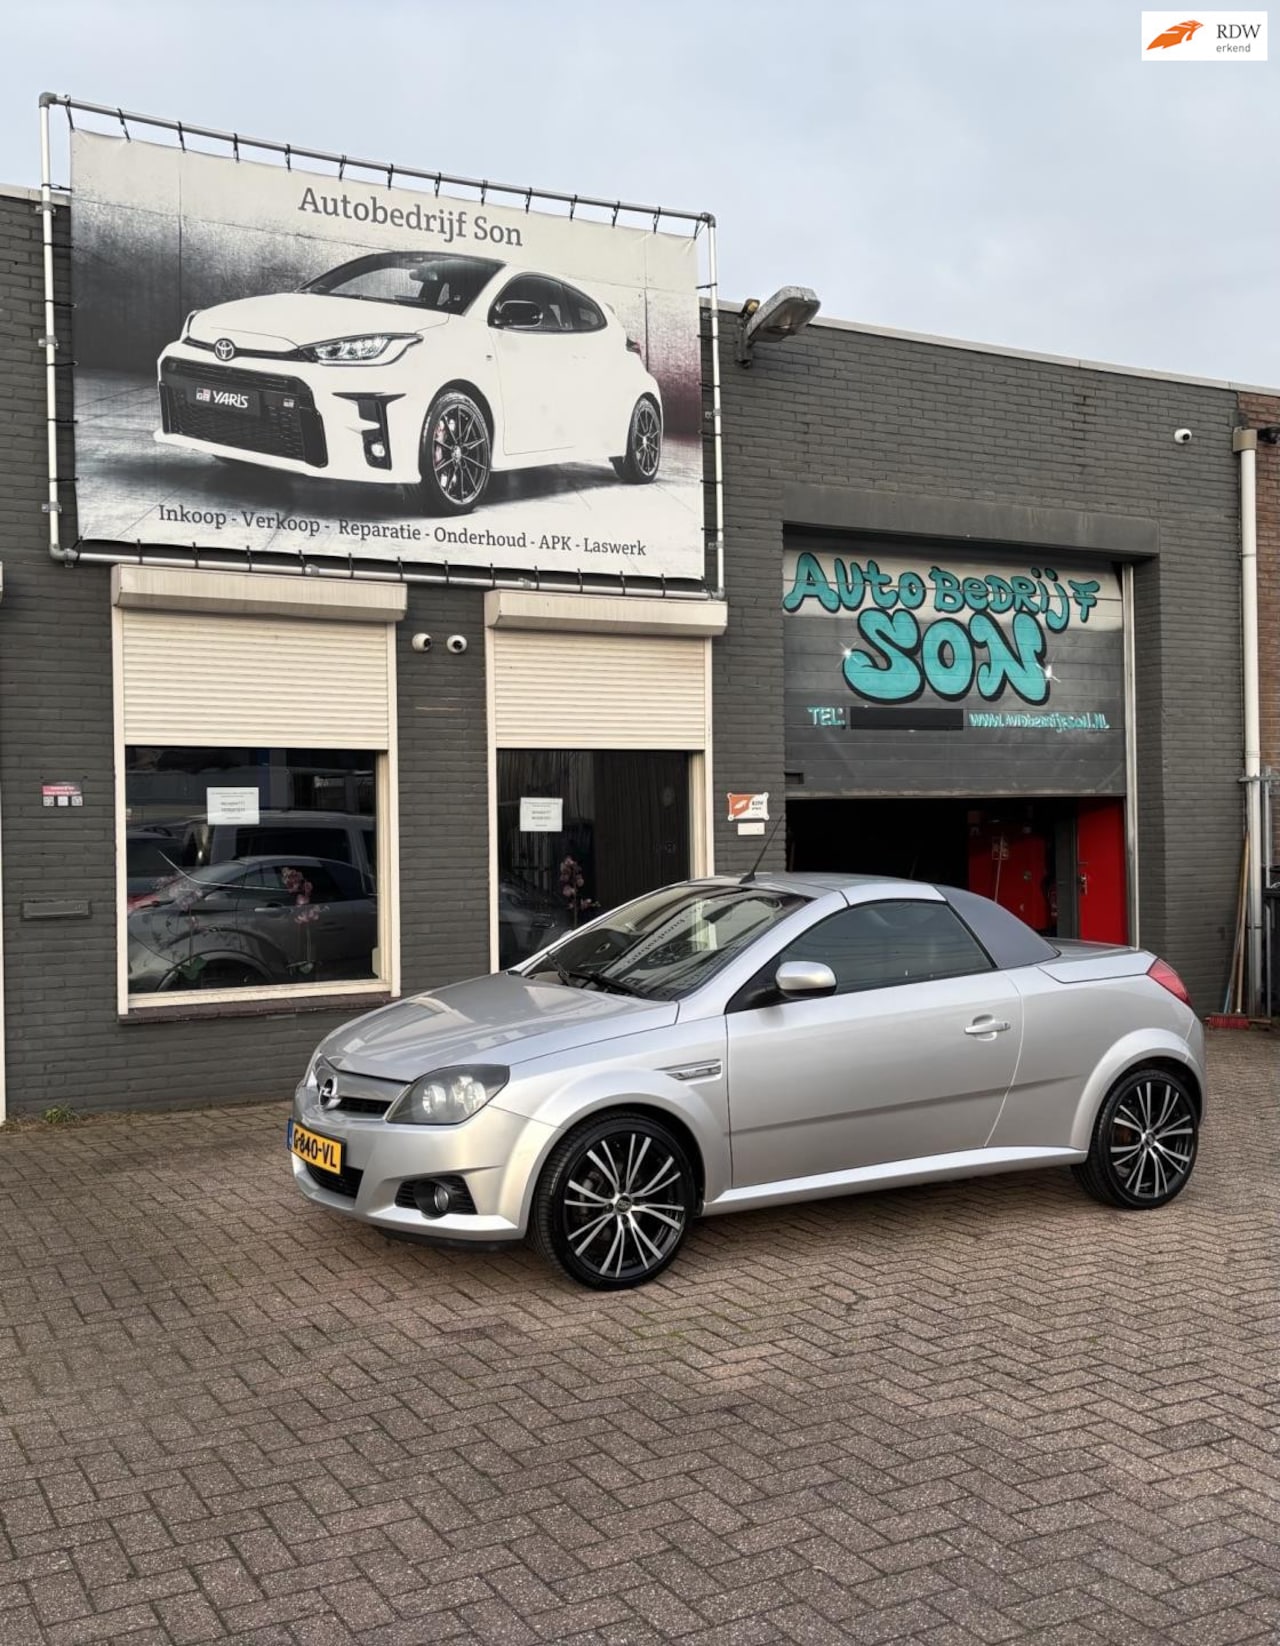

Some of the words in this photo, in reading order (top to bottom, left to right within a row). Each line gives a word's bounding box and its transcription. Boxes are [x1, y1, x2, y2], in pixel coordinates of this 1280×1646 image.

[298, 187, 467, 243] Autobedrijf
[473, 215, 523, 247] Son
[158, 504, 227, 529] Inkoop
[241, 511, 321, 537] Verkoop
[338, 518, 421, 541] Reparatie
[434, 526, 527, 548] Onderhoud
[539, 534, 572, 551] APK
[583, 537, 647, 556] Laswerk
[842, 606, 1051, 706] SON
